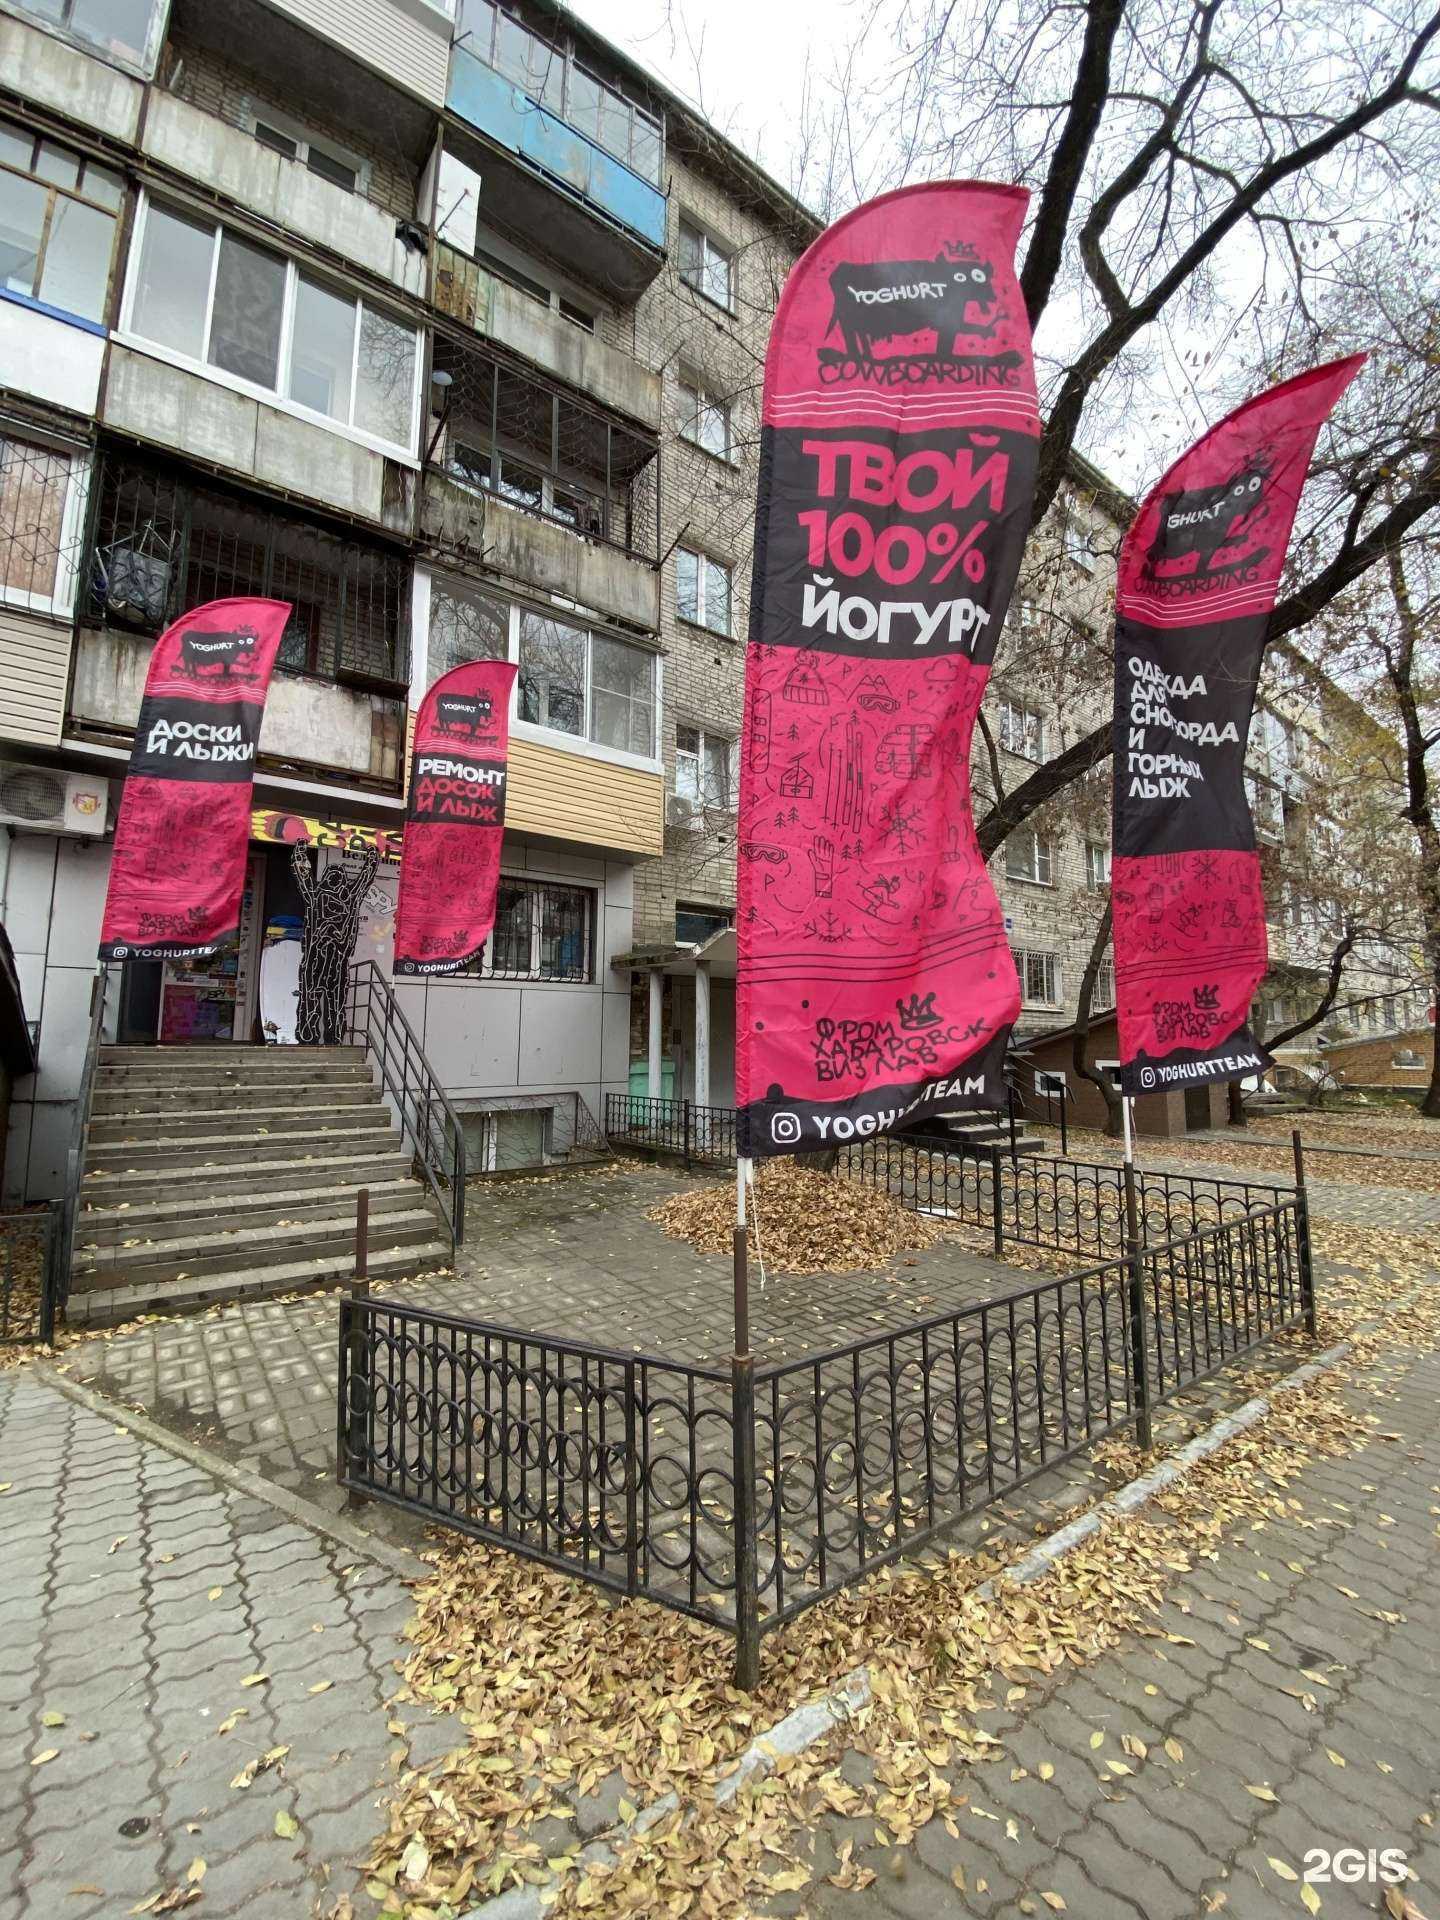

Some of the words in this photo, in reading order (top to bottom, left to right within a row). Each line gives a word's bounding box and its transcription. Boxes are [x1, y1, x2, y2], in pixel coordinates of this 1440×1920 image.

[848, 282, 947, 304] YOGHURT
[818, 361, 1021, 386] COWBOARDING
[802, 432, 1009, 513] ТВОЙ
[1167, 501, 1225, 529] GHURT
[797, 509, 991, 585] 100%
[801, 573, 991, 652] ЙОГУРТ
[189, 640, 235, 652] YOGHURT
[442, 702, 477, 713] YOGHURT
[149, 719, 241, 742] ДОСКИ
[1130, 702, 1240, 747] СНООРДА
[146, 738, 169, 755] И
[173, 741, 255, 762] ЛЫЖИ
[1128, 727, 1146, 750] И
[418, 758, 505, 785] РЕМОНТ
[416, 776, 496, 800] ДОСОК
[1128, 776, 1192, 799] ЛЫЖ
[416, 795, 435, 813] И
[438, 797, 498, 821] ЛЫЖ
[810, 1017, 993, 1062] ХАБАРОВСК
[815, 1017, 896, 1043] ФРОМ
[815, 1059, 867, 1082] ВИЗ
[874, 1045, 939, 1076] ЛАВ
[1157, 1053, 1263, 1083] YOGHURTTEAM
[812, 1074, 985, 1140] YOGHTEAM
